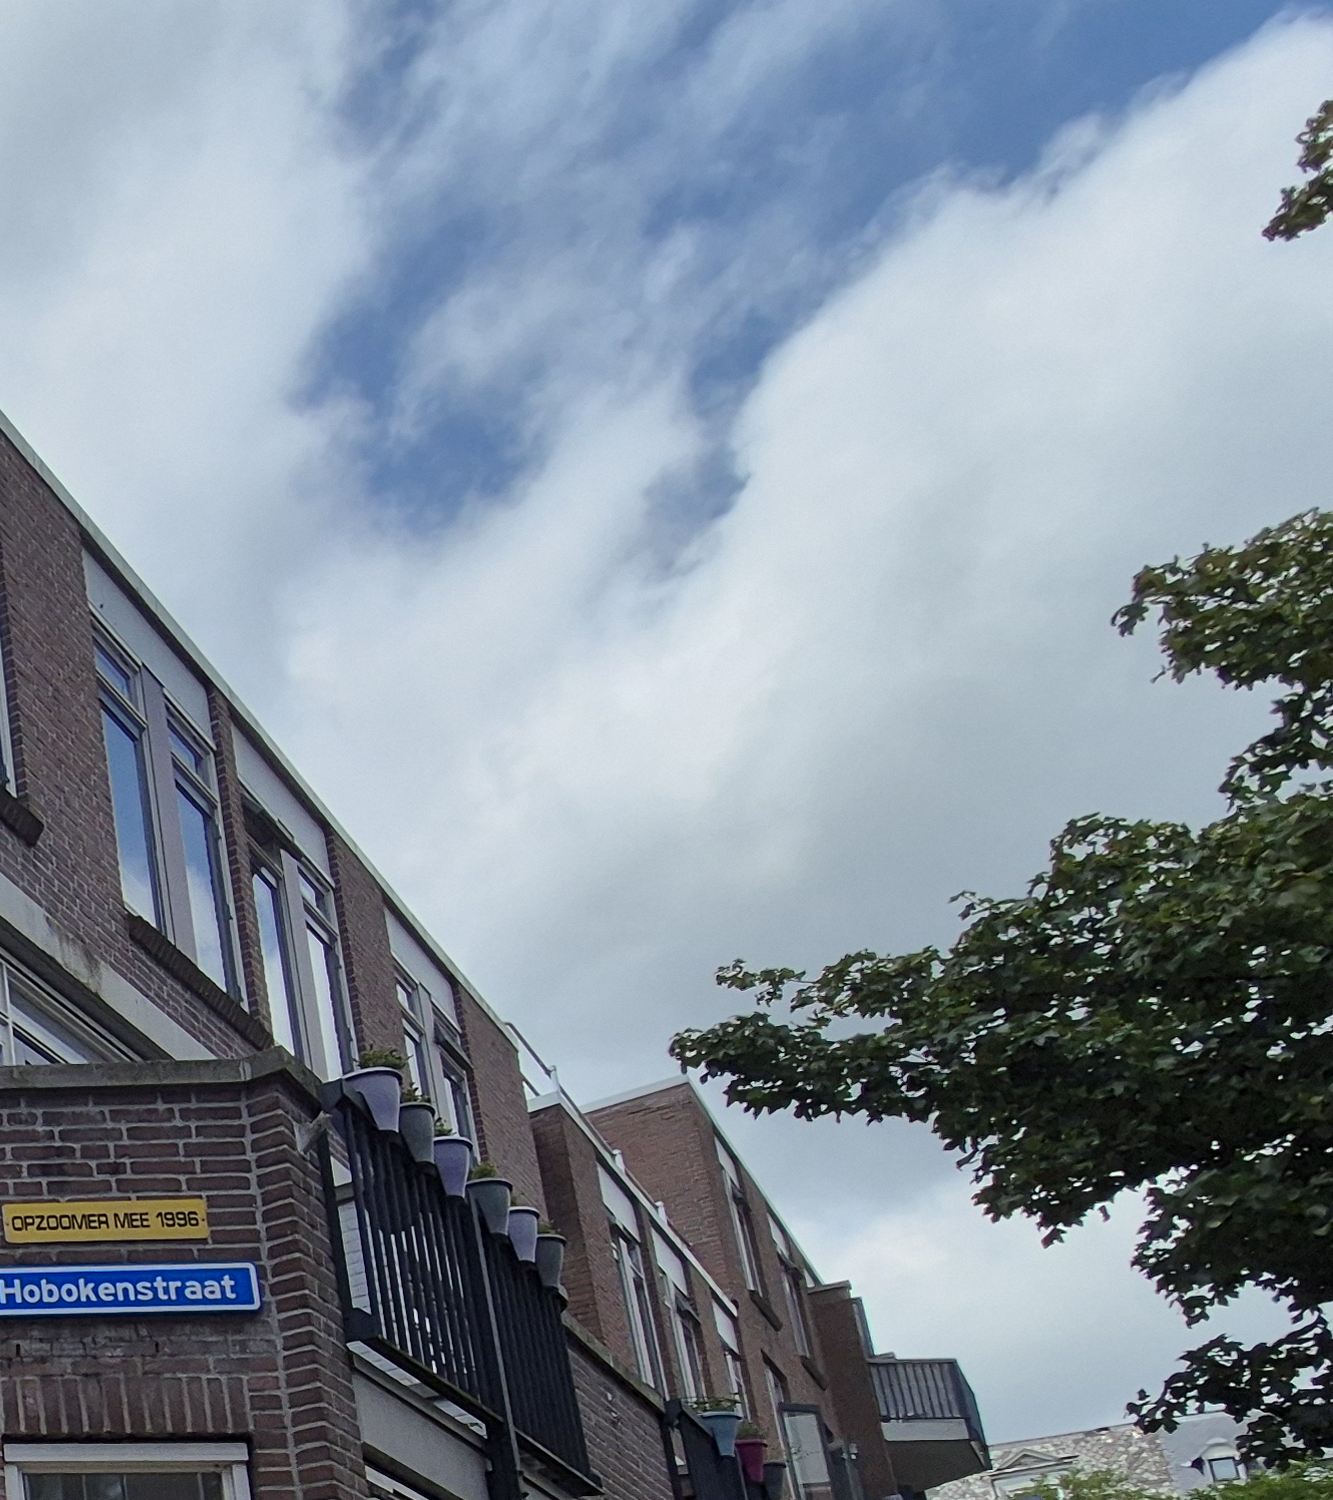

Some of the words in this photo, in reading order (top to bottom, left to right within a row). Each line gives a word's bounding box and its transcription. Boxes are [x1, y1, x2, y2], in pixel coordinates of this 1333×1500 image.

[11, 1212, 110, 1232] OPZOOMER
[113, 1211, 151, 1230] MEE
[155, 1209, 200, 1229] 1996
